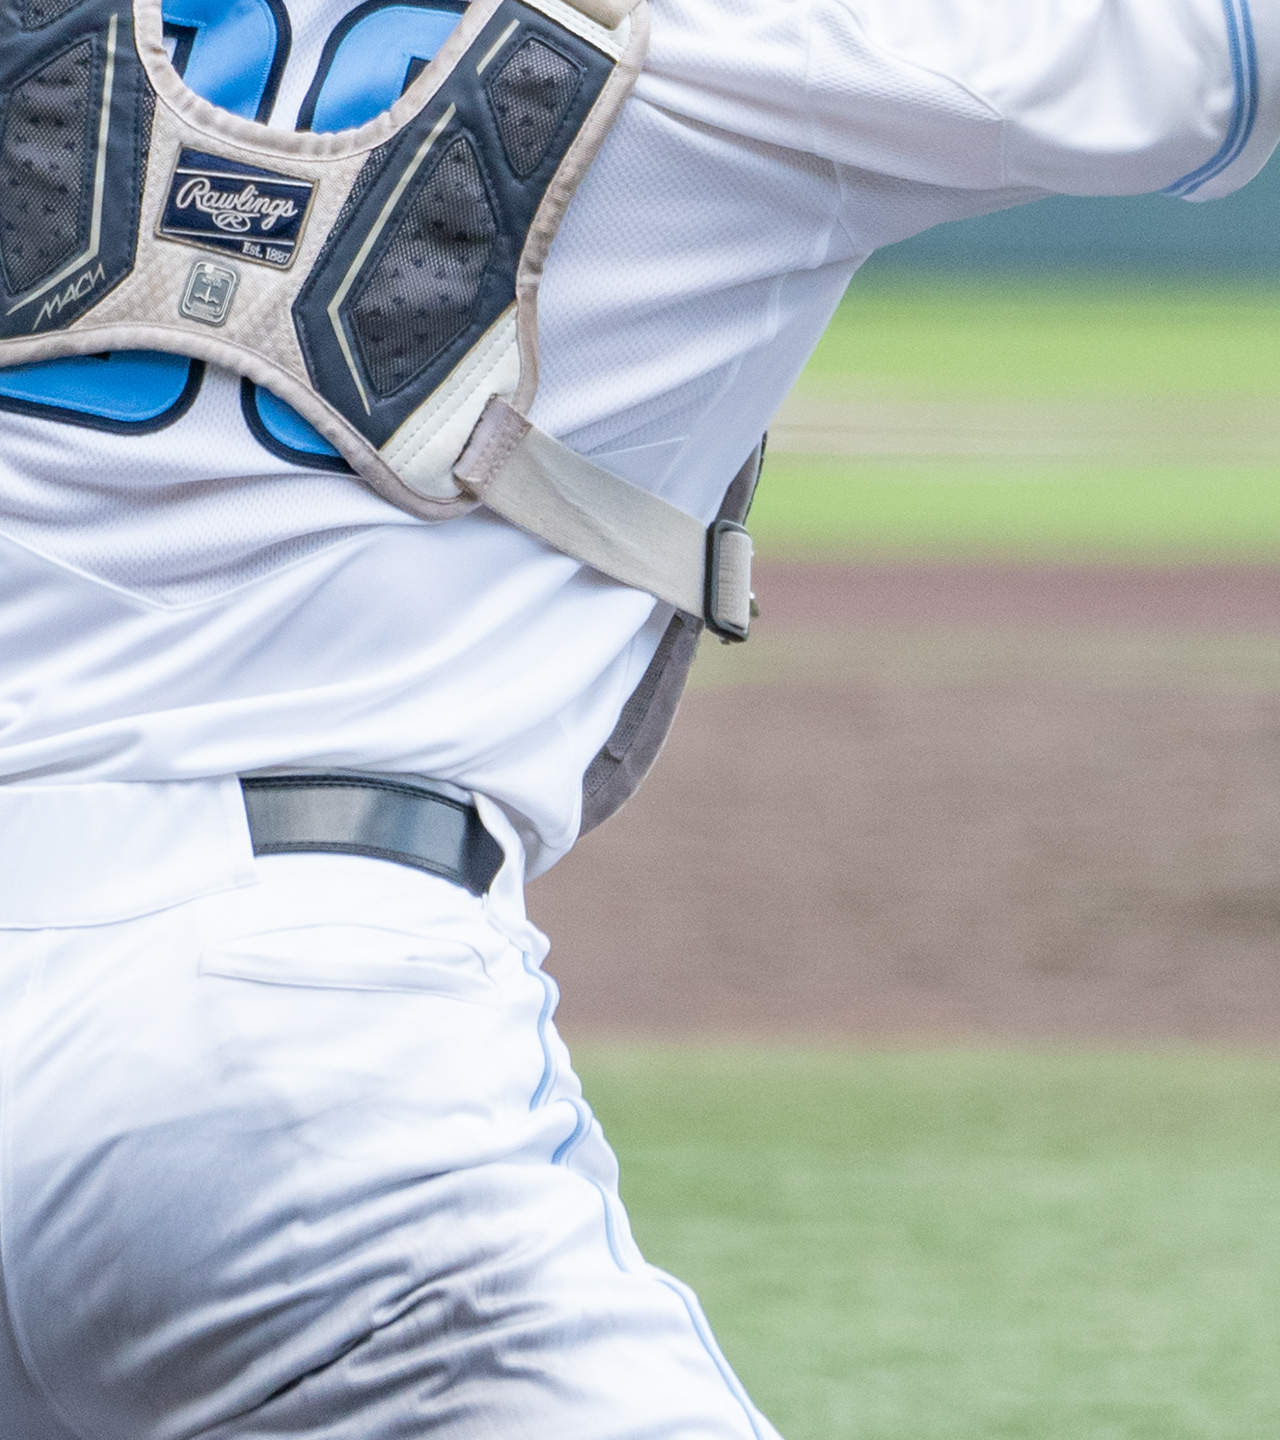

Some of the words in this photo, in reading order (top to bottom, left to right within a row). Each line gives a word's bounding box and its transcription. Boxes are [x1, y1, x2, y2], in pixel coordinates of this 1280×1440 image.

[175, 176, 299, 231] Rawlings
[241, 240, 264, 259] Est.
[265, 246, 291, 265] 1887
